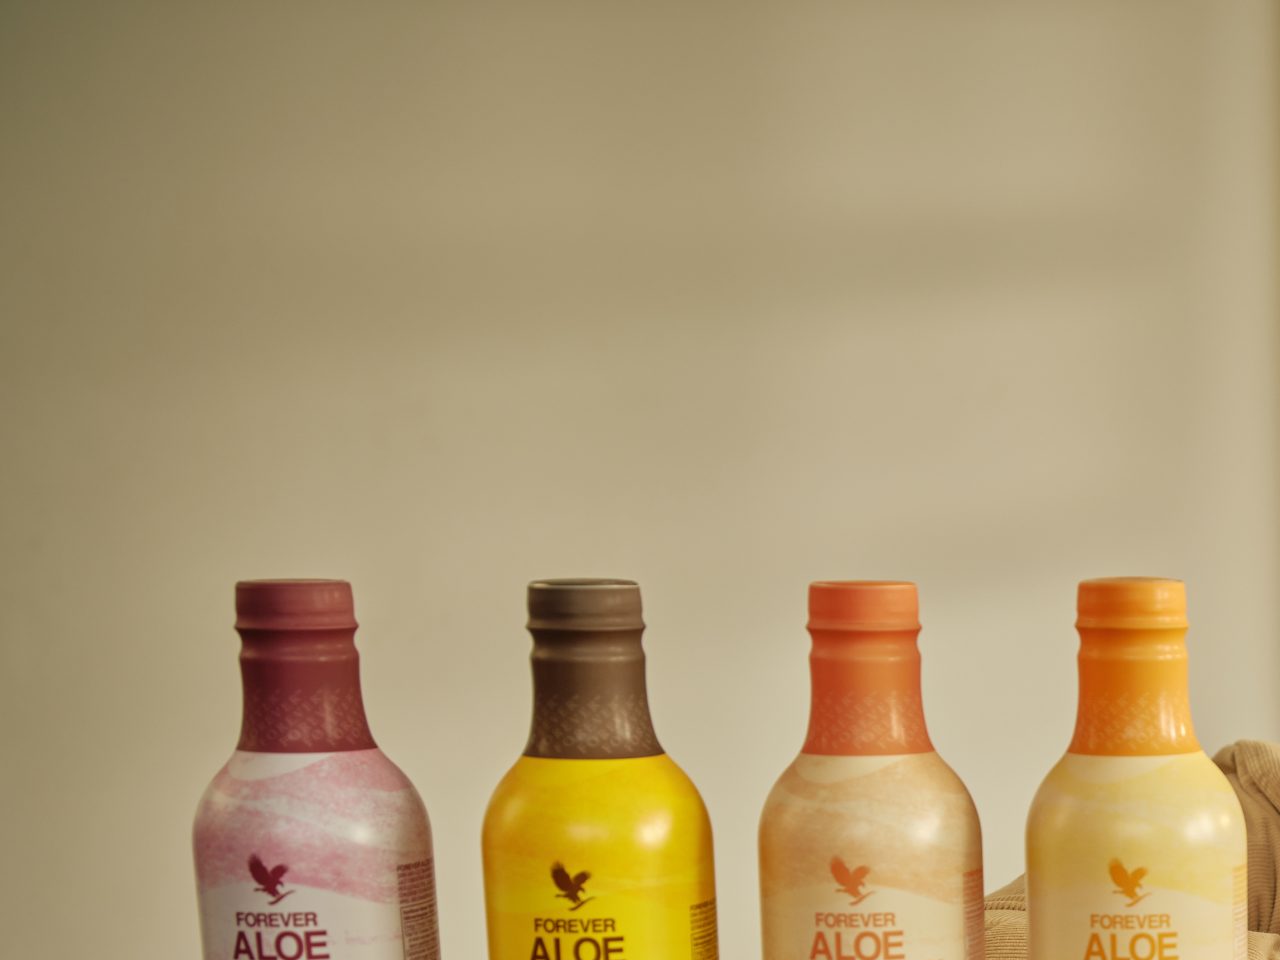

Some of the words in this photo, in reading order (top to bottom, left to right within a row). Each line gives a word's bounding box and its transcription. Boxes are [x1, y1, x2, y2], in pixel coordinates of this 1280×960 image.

[235, 911, 318, 928] FOREVER
[533, 918, 616, 934] FOREVER
[814, 912, 895, 928] FOREVER
[1089, 913, 1171, 929] FOREVER
